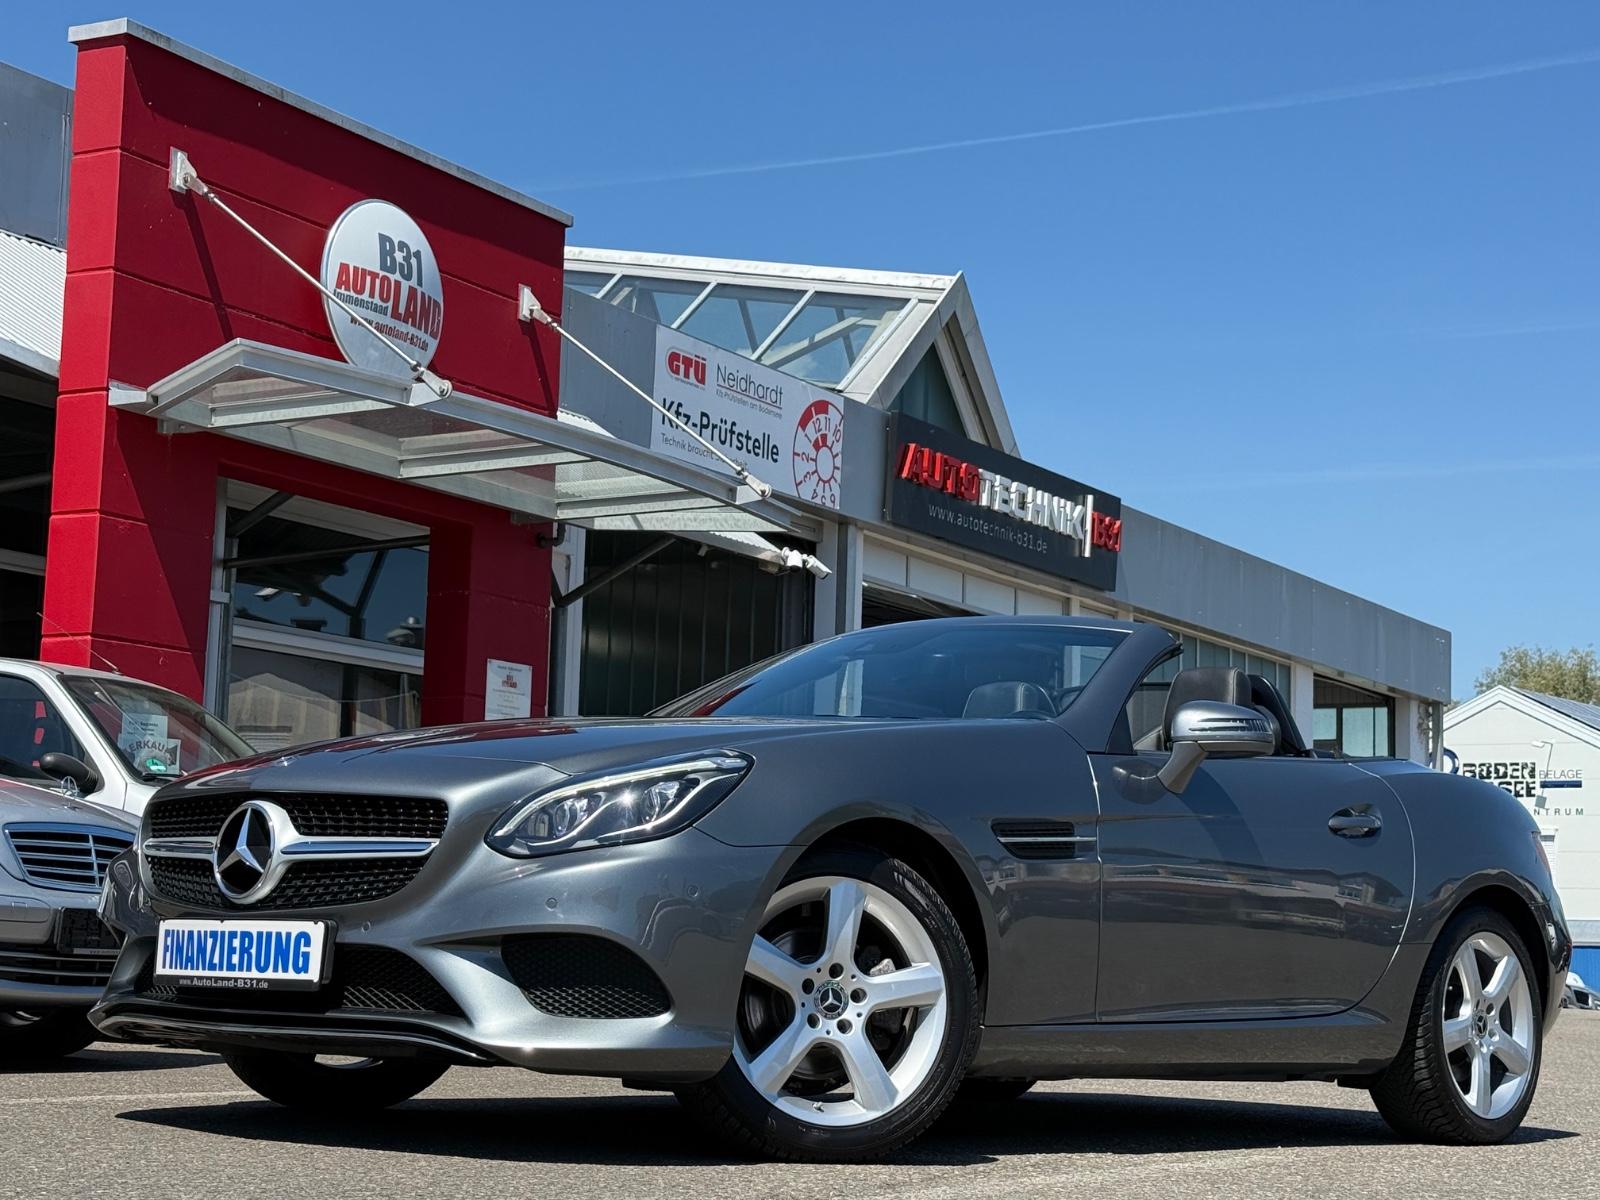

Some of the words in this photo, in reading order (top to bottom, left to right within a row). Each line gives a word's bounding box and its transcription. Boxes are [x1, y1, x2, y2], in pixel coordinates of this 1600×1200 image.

[378, 232, 423, 288] B31
[333, 288, 389, 316] Immenstaad
[335, 262, 442, 340] AUTOLAND
[668, 351, 706, 386] GTÜ
[716, 363, 783, 406] Neidhardt
[662, 397, 779, 463] Kfz-Prüfstelle
[812, 418, 822, 435] 12
[824, 416, 831, 433] 11
[832, 424, 842, 443] 10
[661, 433, 686, 451] Technik
[801, 451, 810, 463] 2
[803, 471, 812, 483] 3
[900, 442, 1085, 541] AUTOTECHNIK
[928, 504, 1048, 554] www.autotechnik-b31.de
[128, 740, 165, 753] ERKAU
[1463, 762, 1536, 780] BODEN
[1539, 769, 1583, 779] BELAGE
[1533, 807, 1584, 816] NTRUM
[162, 929, 312, 975] FINANZIERUNG
